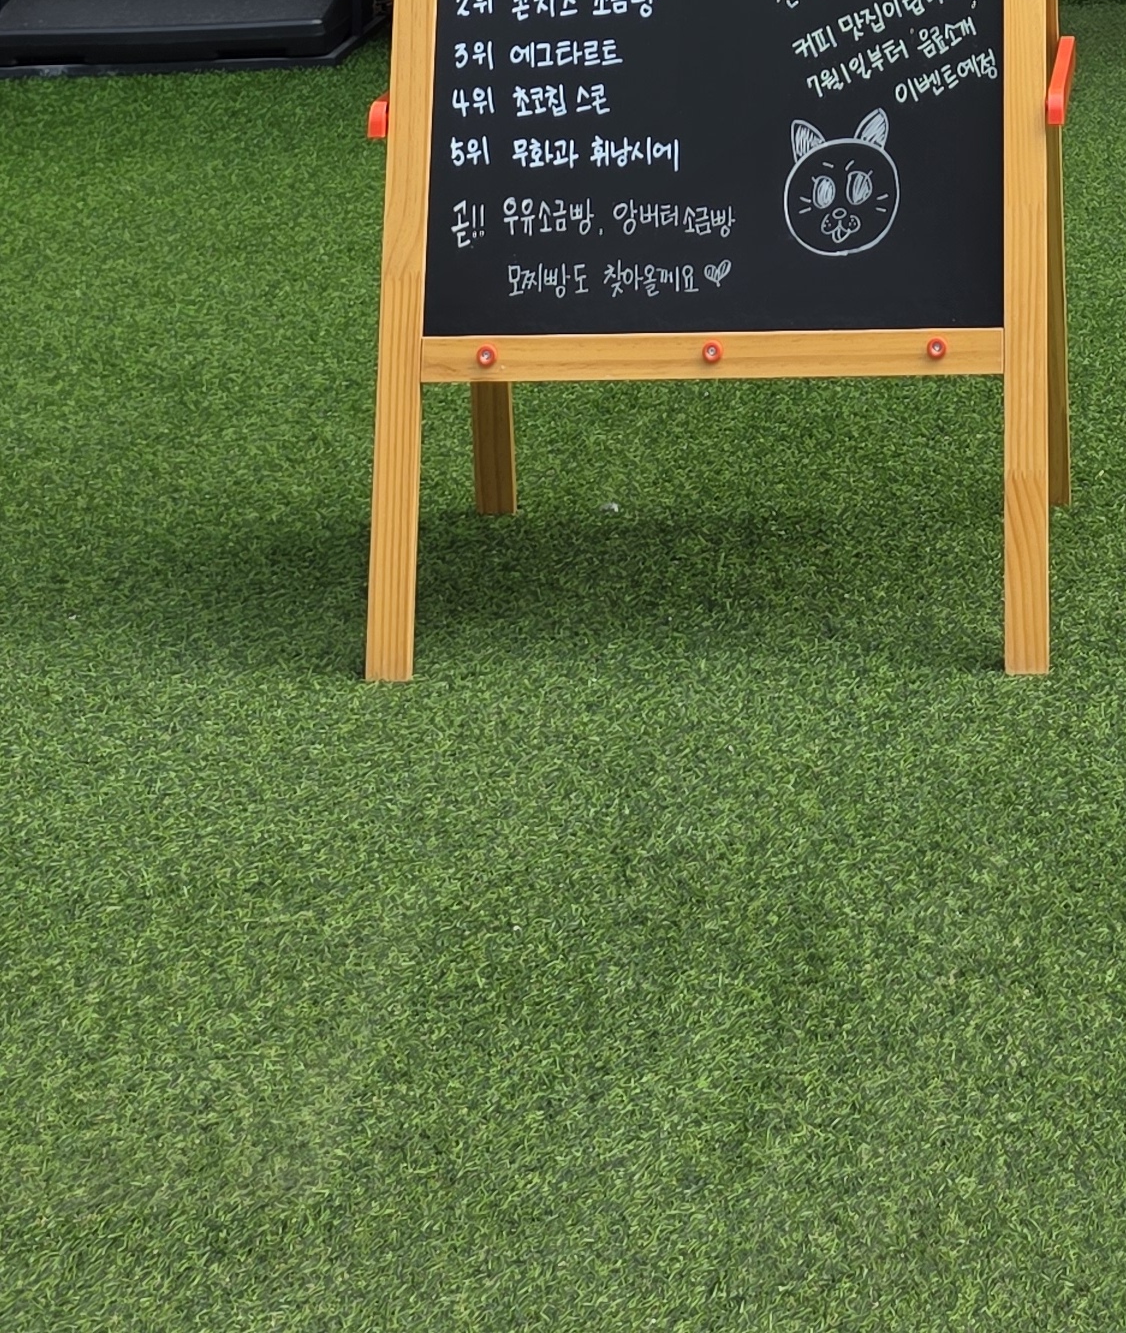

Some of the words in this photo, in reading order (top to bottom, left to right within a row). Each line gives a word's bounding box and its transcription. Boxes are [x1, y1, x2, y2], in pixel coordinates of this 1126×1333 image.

[454, 39, 495, 71] 3위
[509, 38, 624, 68] 에그타르트
[792, 25, 838, 59] 커피
[451, 86, 495, 118] 4위
[512, 83, 568, 118] 초코칩
[575, 83, 611, 115] 스콘
[450, 135, 490, 167] 5위
[511, 137, 580, 169] 무화과
[589, 134, 680, 172] 휘낭시에
[507, 261, 590, 299] 모찌빵도
[603, 258, 700, 299] 찾아올께요
